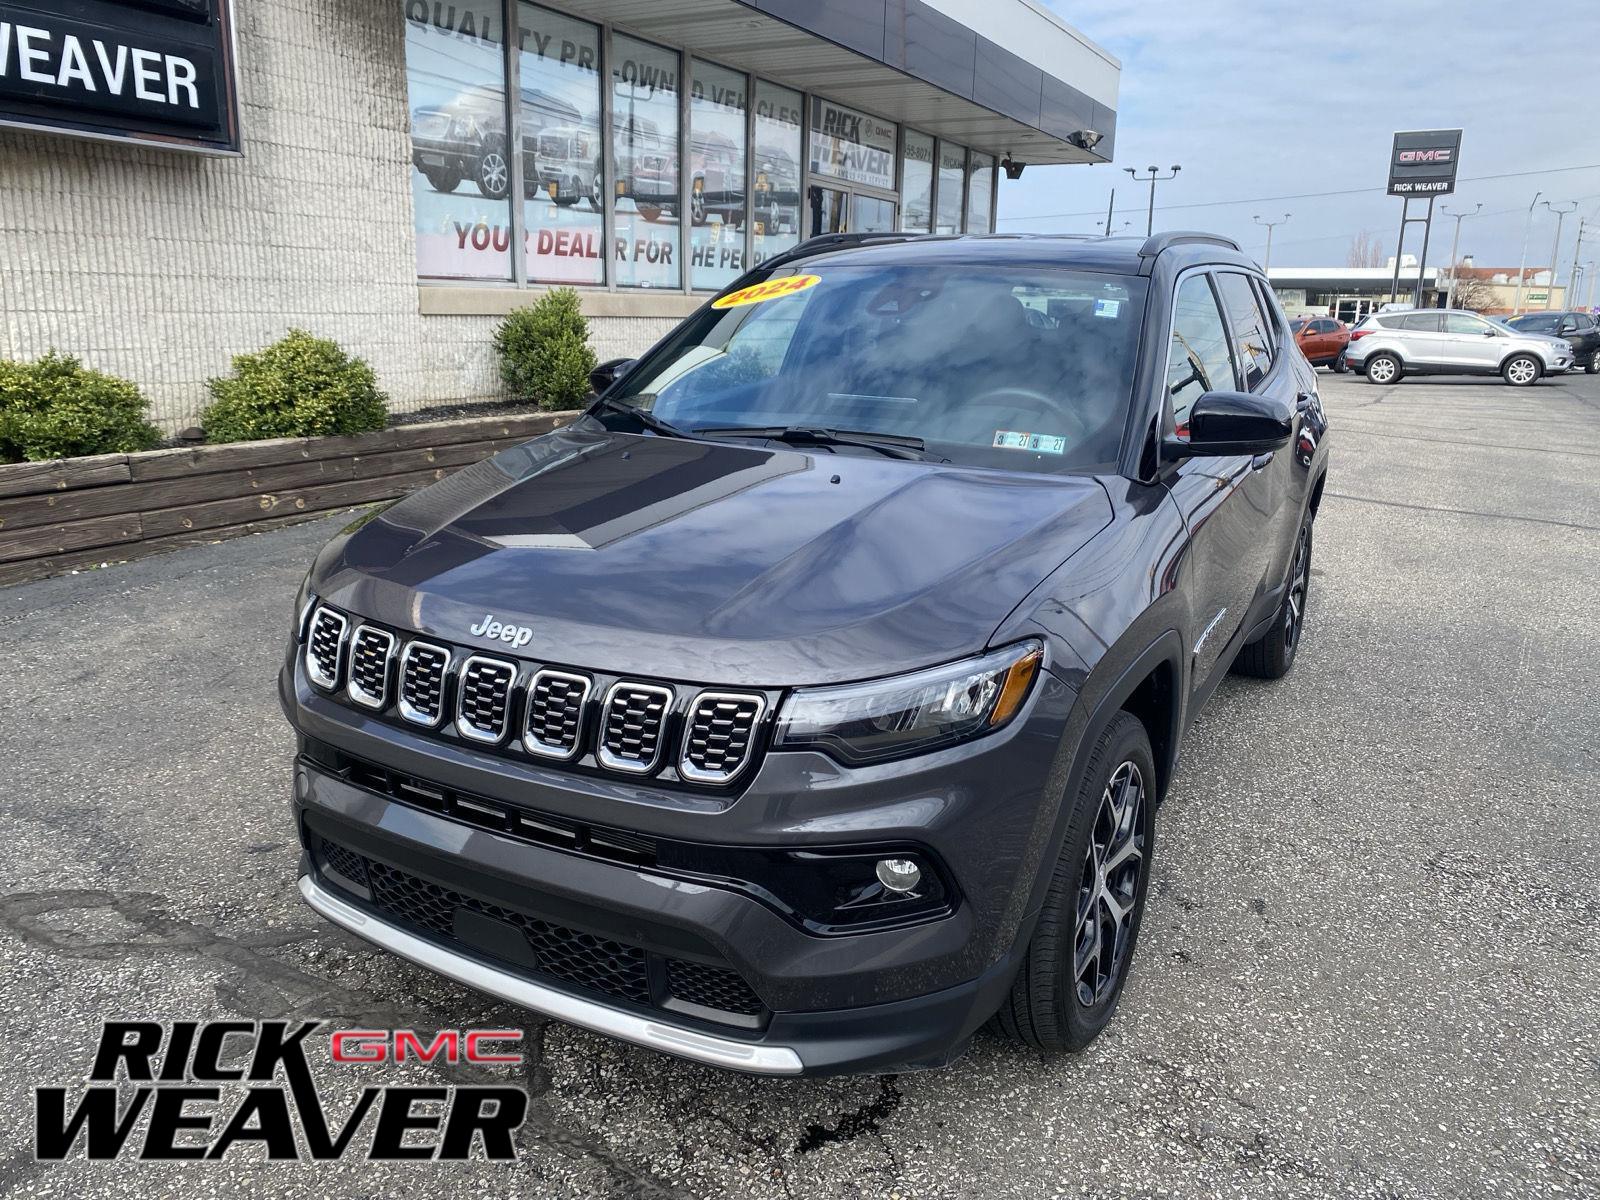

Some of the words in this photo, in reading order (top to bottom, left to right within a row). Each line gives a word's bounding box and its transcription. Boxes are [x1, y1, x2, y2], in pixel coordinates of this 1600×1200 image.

[405, 0, 551, 61] QUALTY
[560, 40, 704, 103] PR-OWND
[711, 84, 800, 130] VEHCLES
[823, 106, 863, 145] RICK
[811, 134, 890, 176] WEAVER
[1399, 150, 1451, 161] GMC
[1393, 183, 1413, 192] RICK
[1414, 182, 1448, 191] WEAVER
[537, 229, 627, 261] DEALR
[634, 239, 672, 265] FOR
[691, 246, 715, 267] HE
[721, 276, 811, 304] 2024
[470, 614, 533, 649] Jeep
